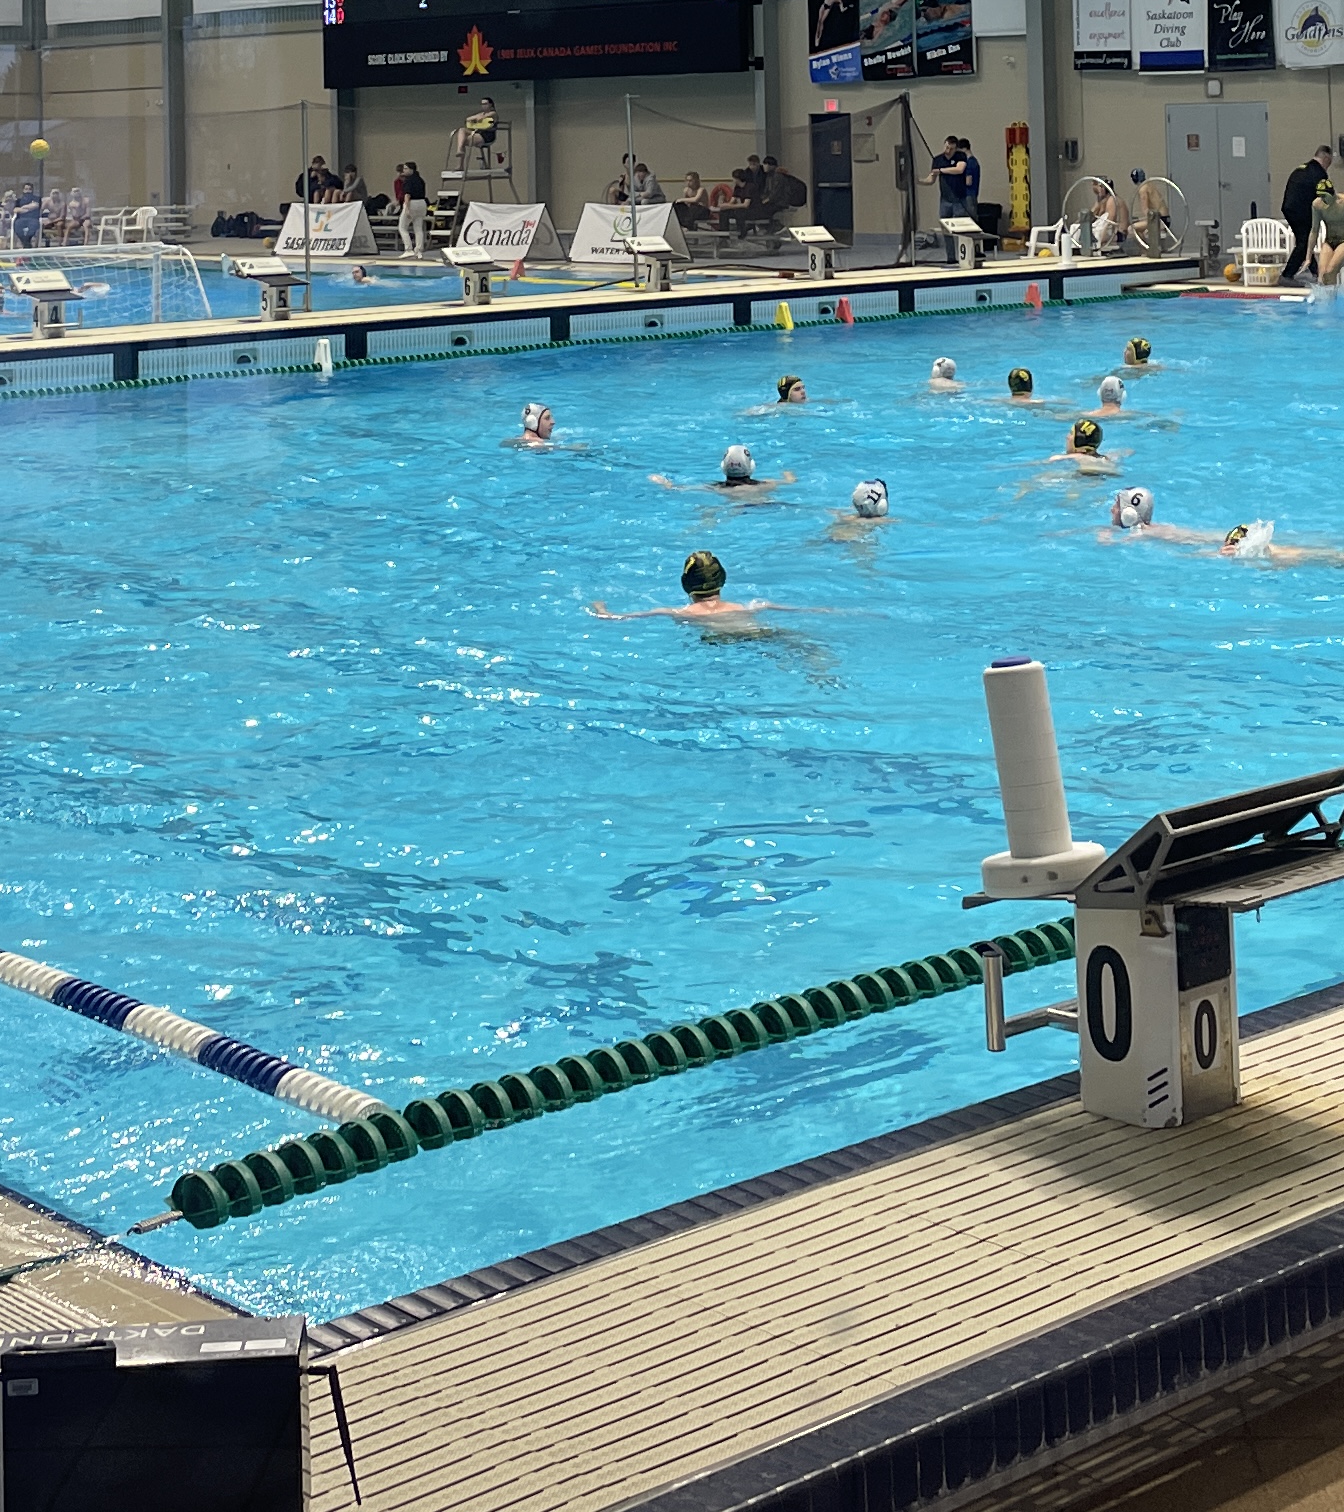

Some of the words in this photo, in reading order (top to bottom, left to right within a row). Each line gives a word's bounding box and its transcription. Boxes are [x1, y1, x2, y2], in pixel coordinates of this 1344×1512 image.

[1146, 9, 1194, 21] Saskatoon
[1213, 0, 1244, 32] Play
[1154, 24, 1187, 36] Diving
[536, 46, 572, 58] CANADA
[573, 45, 603, 56] GAMES
[605, 42, 661, 55] FOUNDATION
[663, 41, 679, 52] INC
[1159, 37, 1182, 48] Club
[463, 219, 532, 246] Canada
[960, 243, 967, 260] 9
[1080, 421, 1096, 436] 14
[1131, 492, 1144, 506] 6
[1086, 944, 1132, 1062] 0
[1194, 999, 1217, 1070] 0
